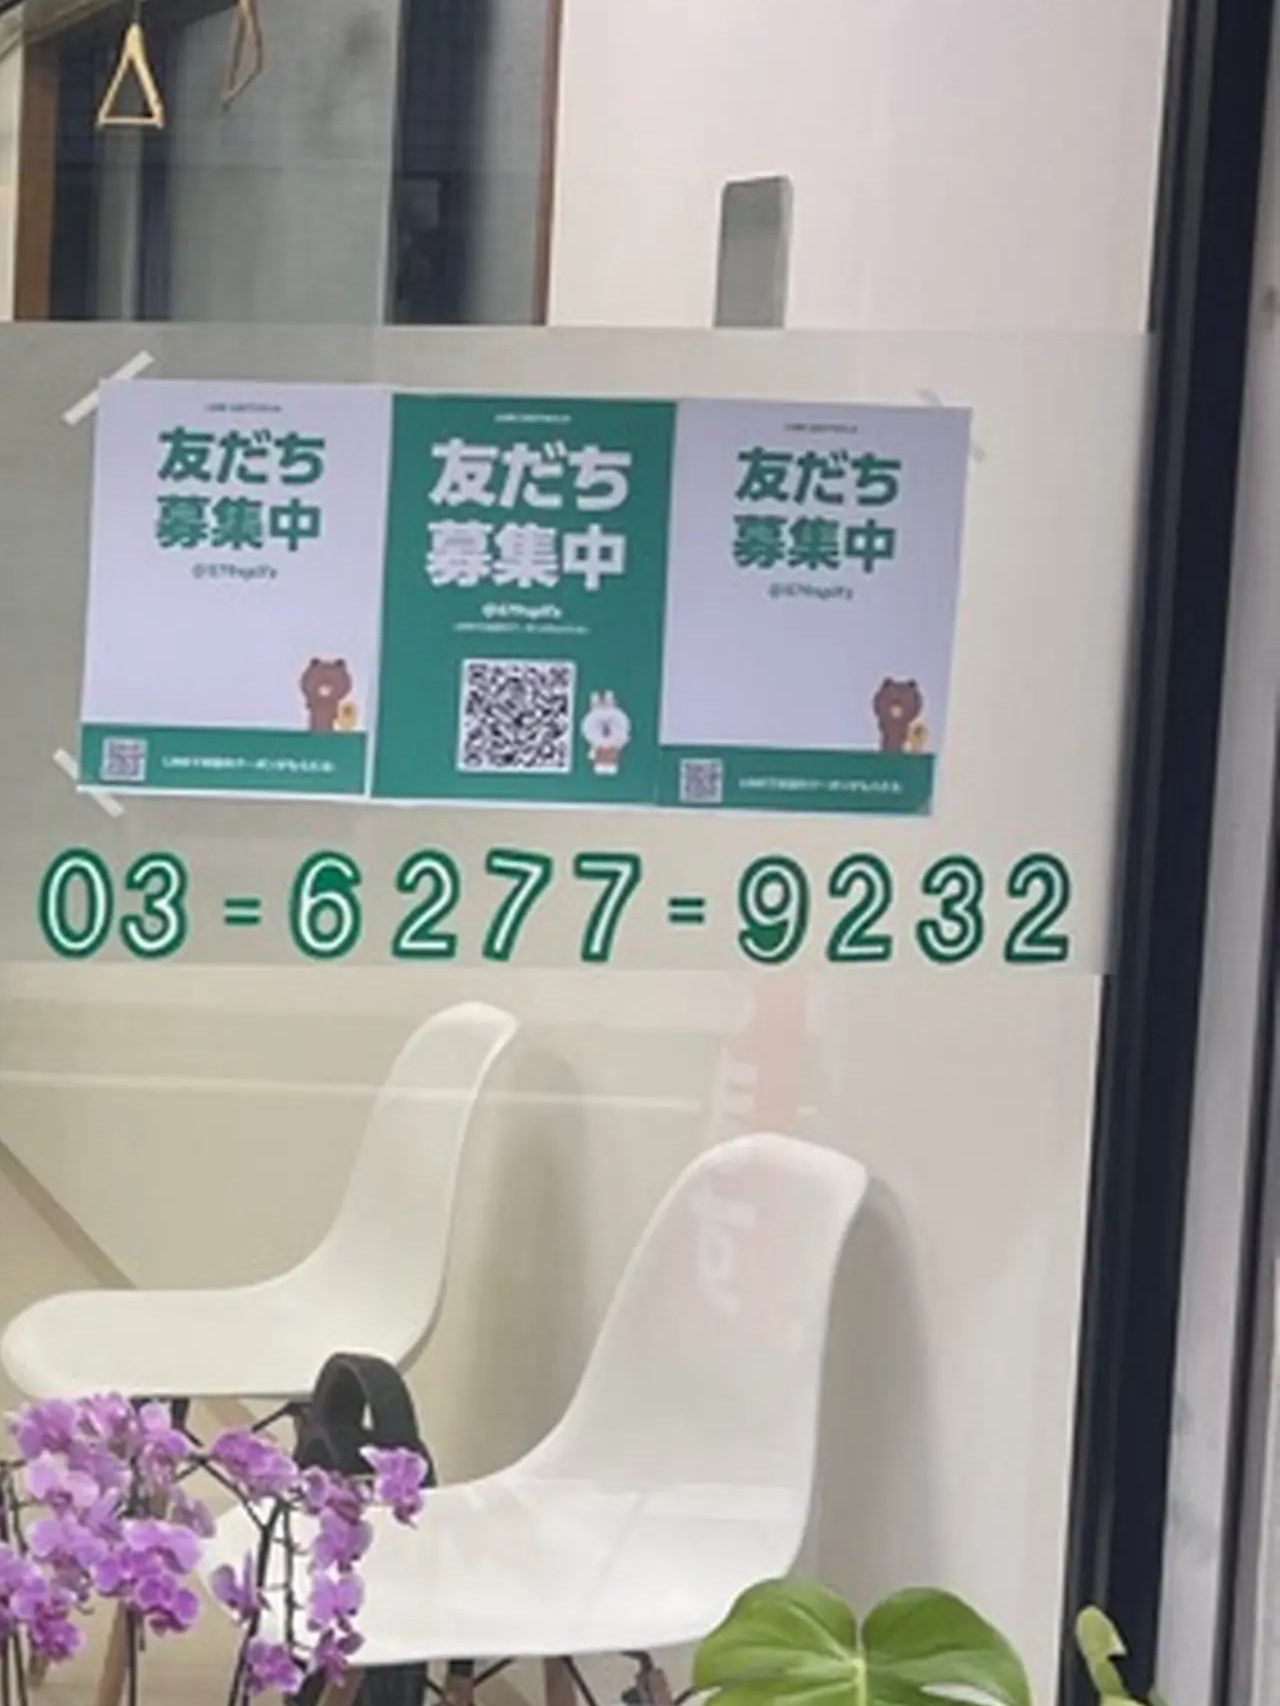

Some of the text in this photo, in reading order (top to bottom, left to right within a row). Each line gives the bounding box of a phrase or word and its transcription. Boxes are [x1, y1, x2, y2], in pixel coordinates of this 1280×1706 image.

[157, 425, 326, 486] 友だち
[428, 437, 633, 511] 友だち
[734, 445, 903, 508] 友だち
[154, 493, 323, 553] 募集中
[731, 514, 898, 574] 募集中
[425, 518, 627, 592] 募集中
